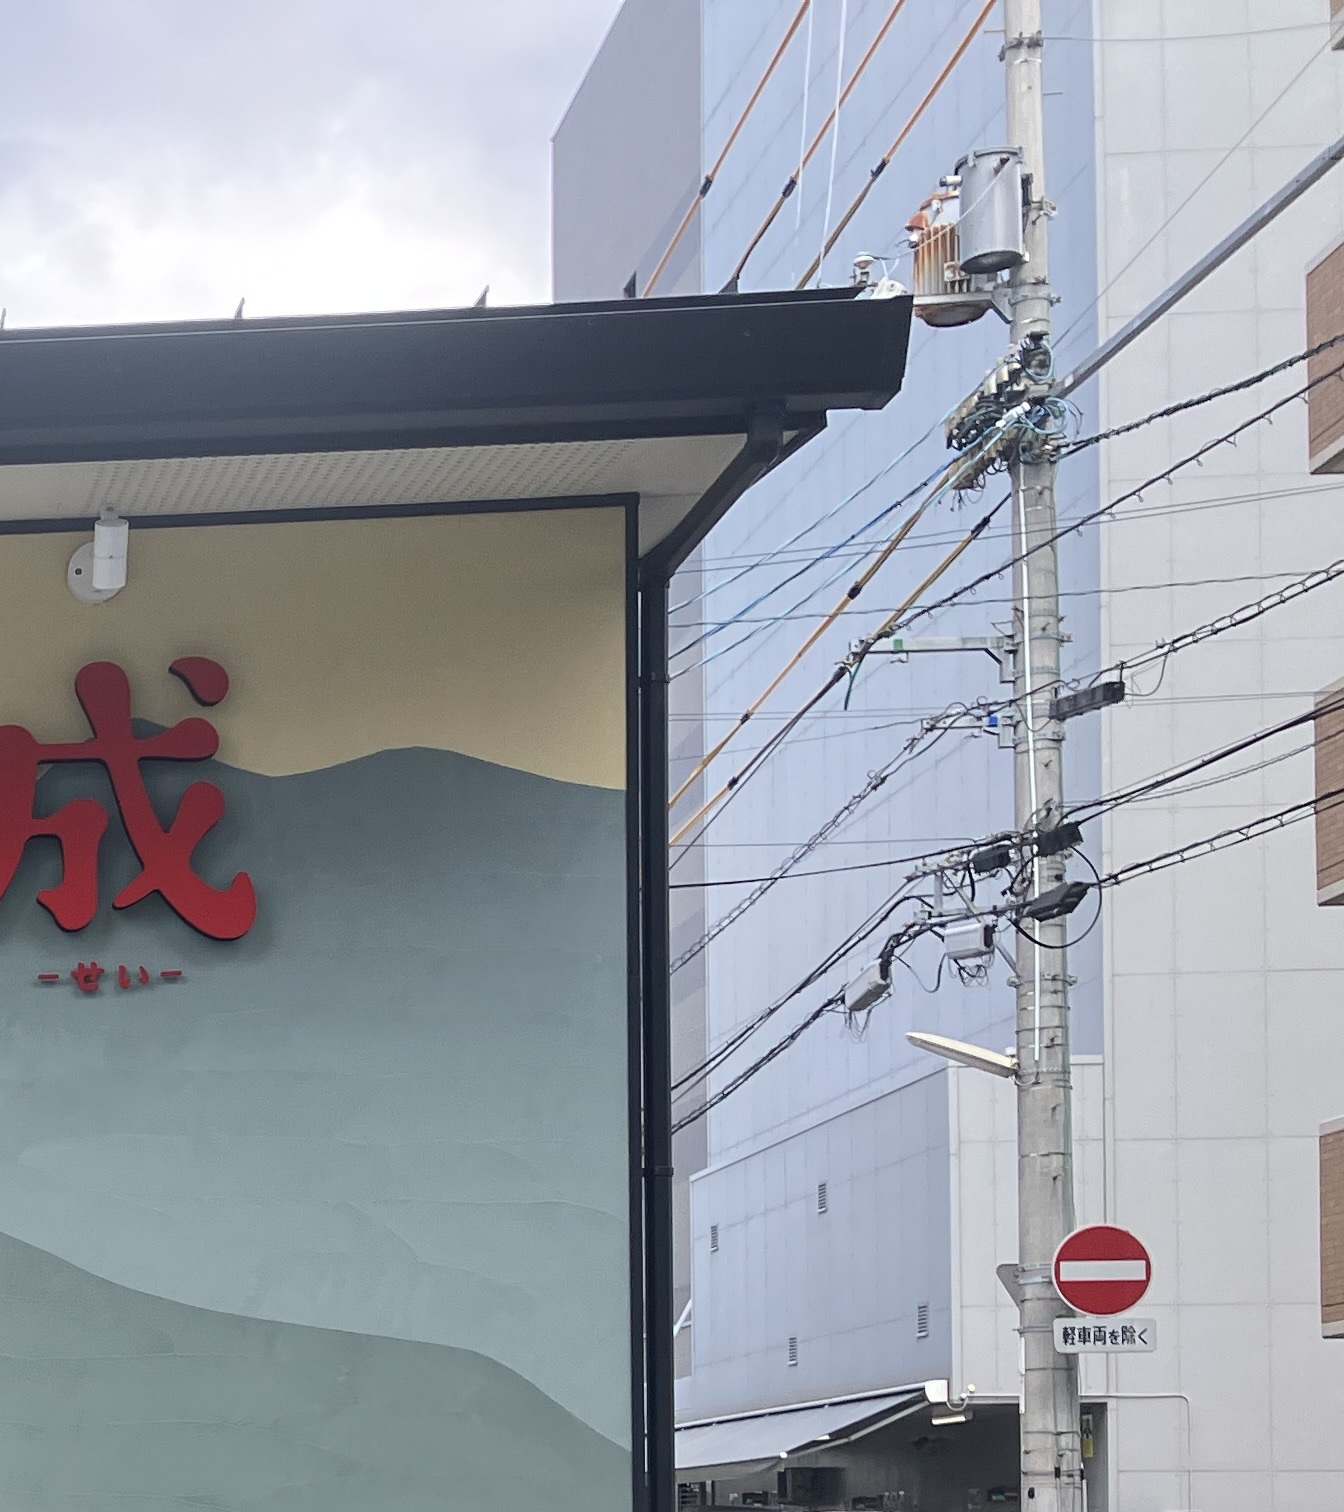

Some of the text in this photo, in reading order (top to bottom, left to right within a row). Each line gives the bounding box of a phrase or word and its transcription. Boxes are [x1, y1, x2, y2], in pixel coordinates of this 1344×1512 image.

[1062, 1325, 1148, 1346] 軽車両を除く
